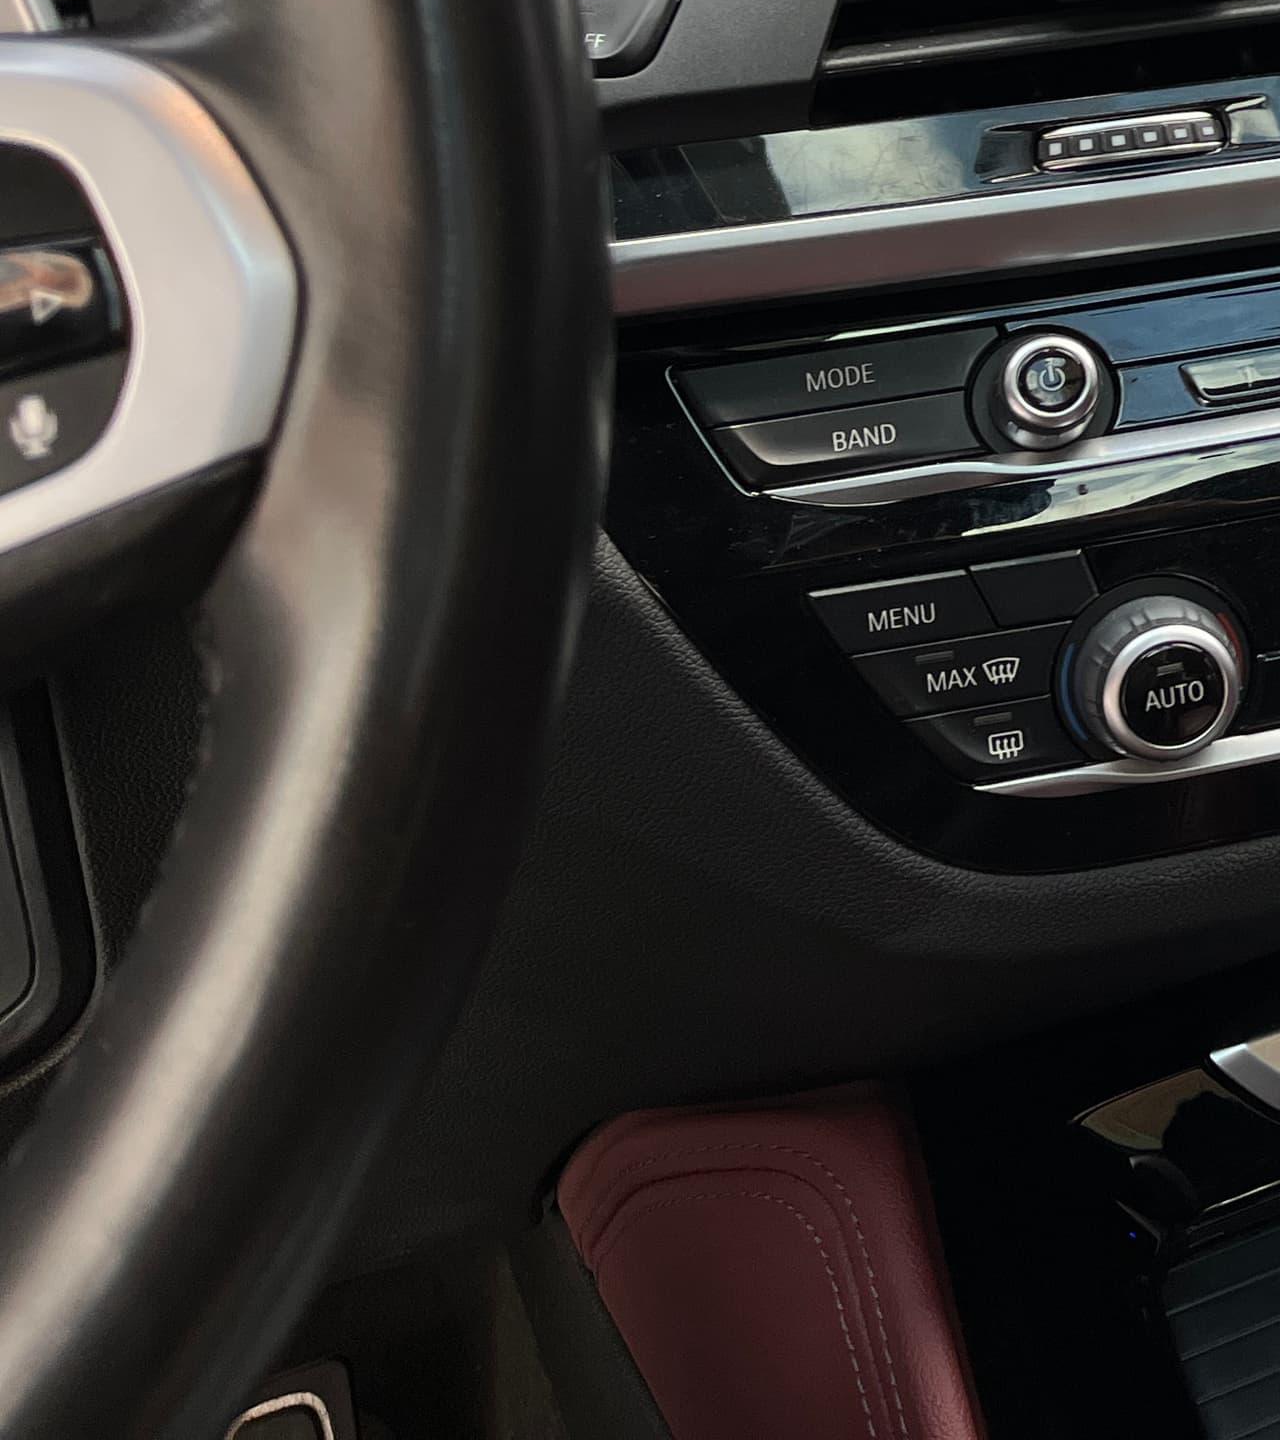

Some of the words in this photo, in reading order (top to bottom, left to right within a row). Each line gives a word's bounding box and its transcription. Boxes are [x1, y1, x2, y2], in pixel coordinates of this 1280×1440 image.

[806, 363, 875, 392] MODE
[832, 423, 897, 452] BAND
[867, 602, 937, 633] MENU
[926, 666, 978, 693] MAX
[1144, 679, 1205, 712] AUTO
